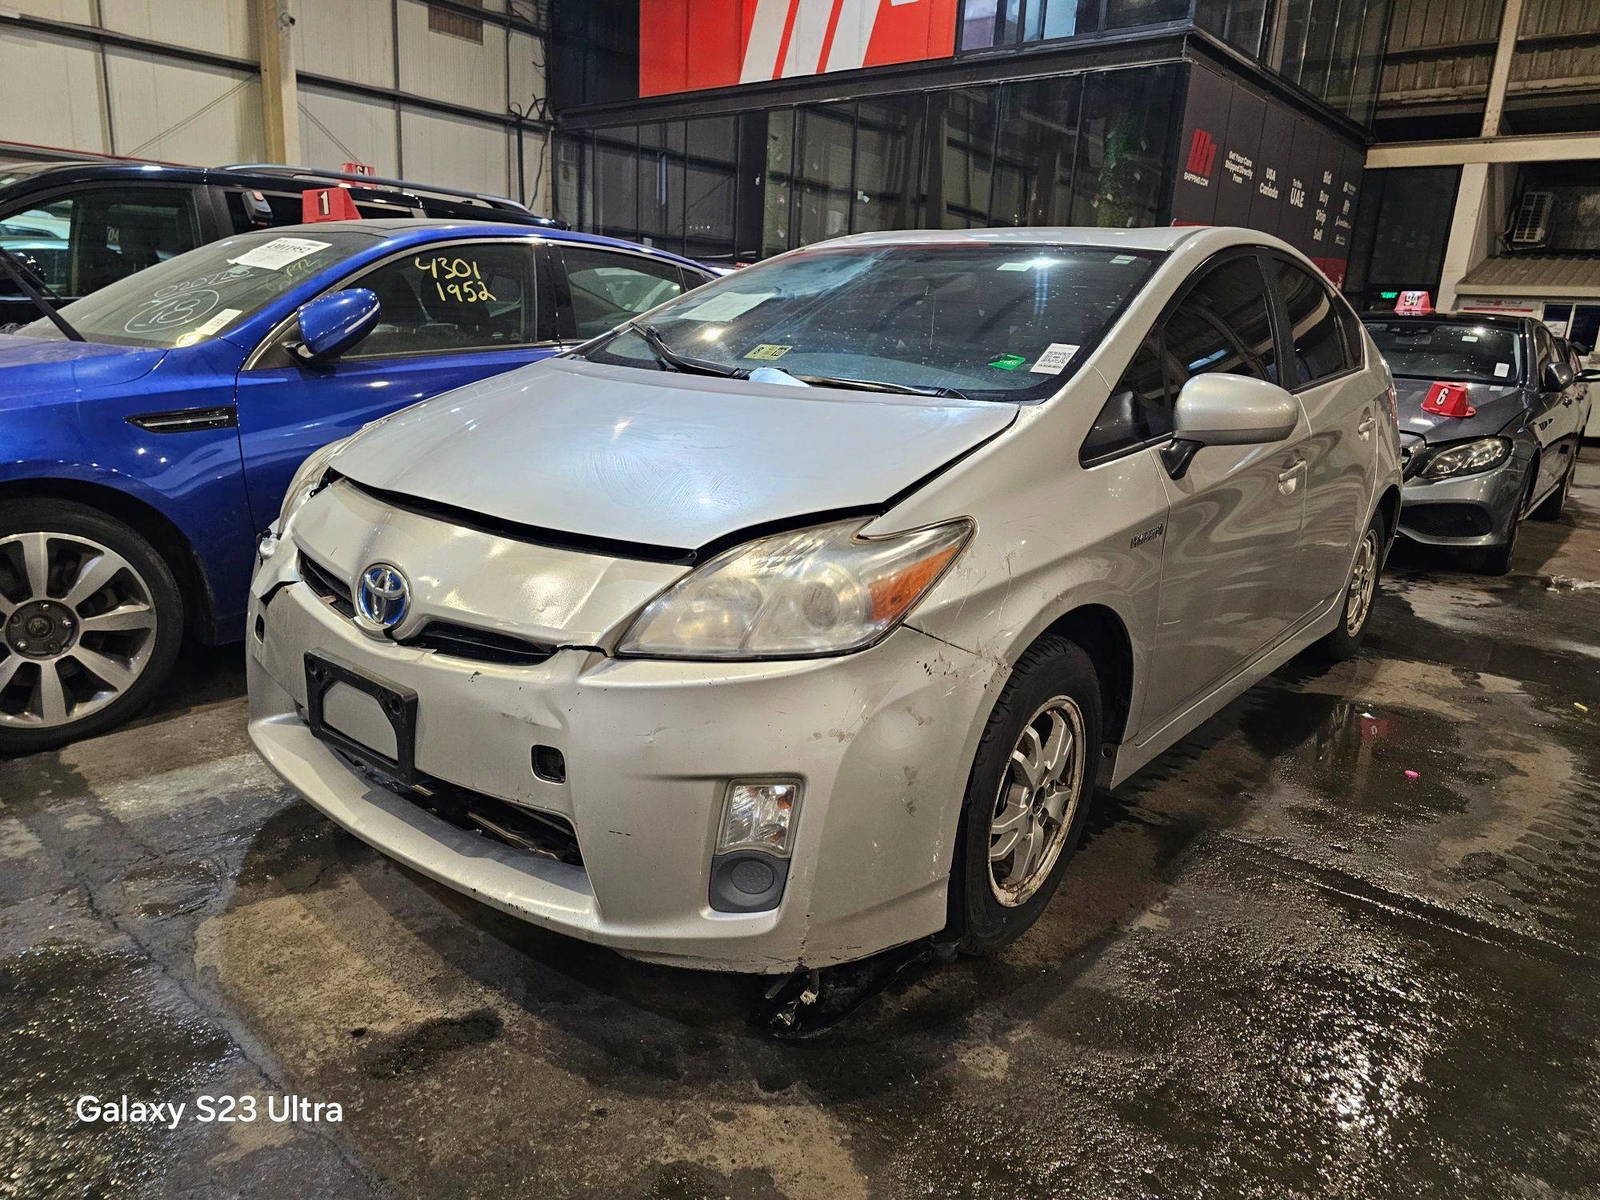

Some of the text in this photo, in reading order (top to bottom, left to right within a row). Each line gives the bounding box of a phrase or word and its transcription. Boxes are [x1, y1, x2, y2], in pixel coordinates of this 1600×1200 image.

[1266, 167, 1276, 182] USA
[1260, 182, 1279, 199] Canada
[1290, 187, 1305, 208] UAE
[1319, 190, 1329, 207] Buy
[320, 191, 330, 215] 1
[415, 257, 481, 279] 4301
[436, 281, 497, 302] 1952
[1404, 294, 1419, 306] 94
[1436, 388, 1449, 405] 6
